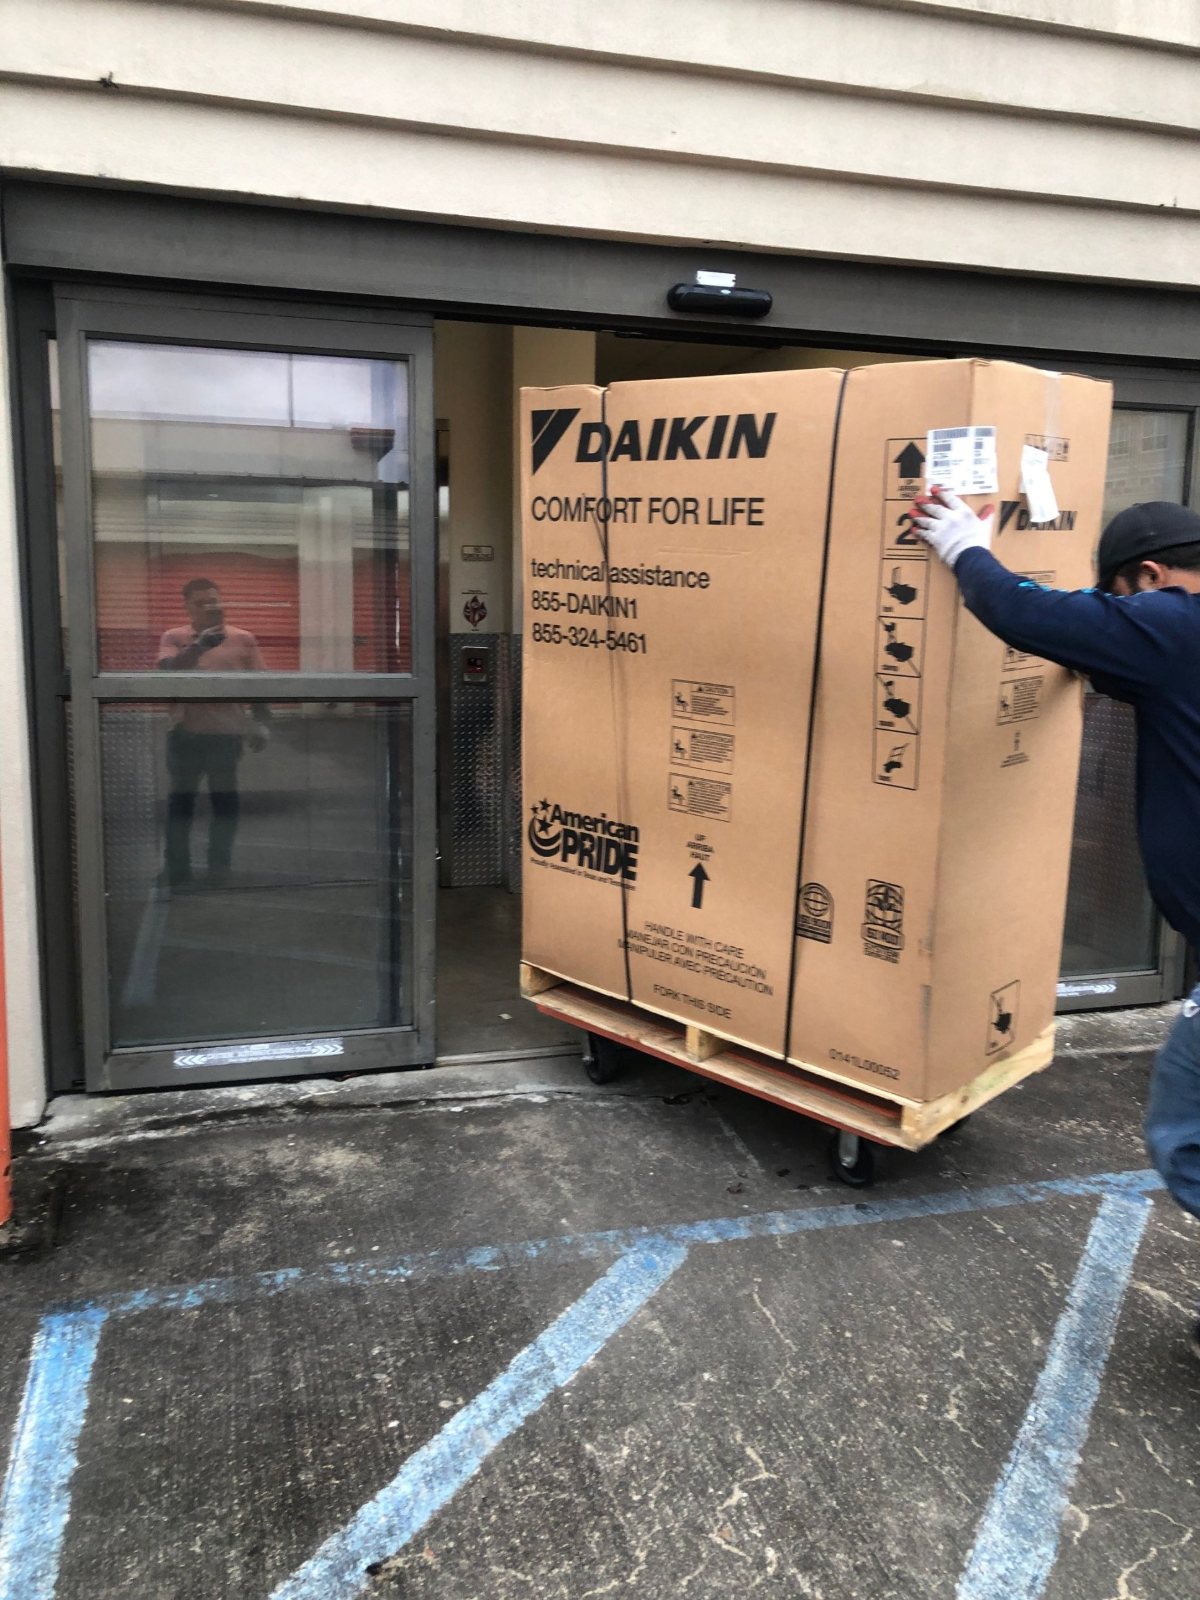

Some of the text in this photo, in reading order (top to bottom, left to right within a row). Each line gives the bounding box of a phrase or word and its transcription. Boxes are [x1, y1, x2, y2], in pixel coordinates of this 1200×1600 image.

[576, 412, 778, 463] DAIKIN
[531, 496, 765, 526] COMFORT FOR LIFE
[531, 558, 711, 589] technical assistance
[531, 590, 638, 619] 855-DAIKIN1
[532, 622, 648, 654] 855-324-5461
[550, 803, 640, 843] American
[560, 827, 640, 881] PRIDE
[644, 921, 744, 959] HANDLE WITH CARE
[670, 942, 694, 958] CON
[653, 983, 733, 1020] FORK THIS SIDE
